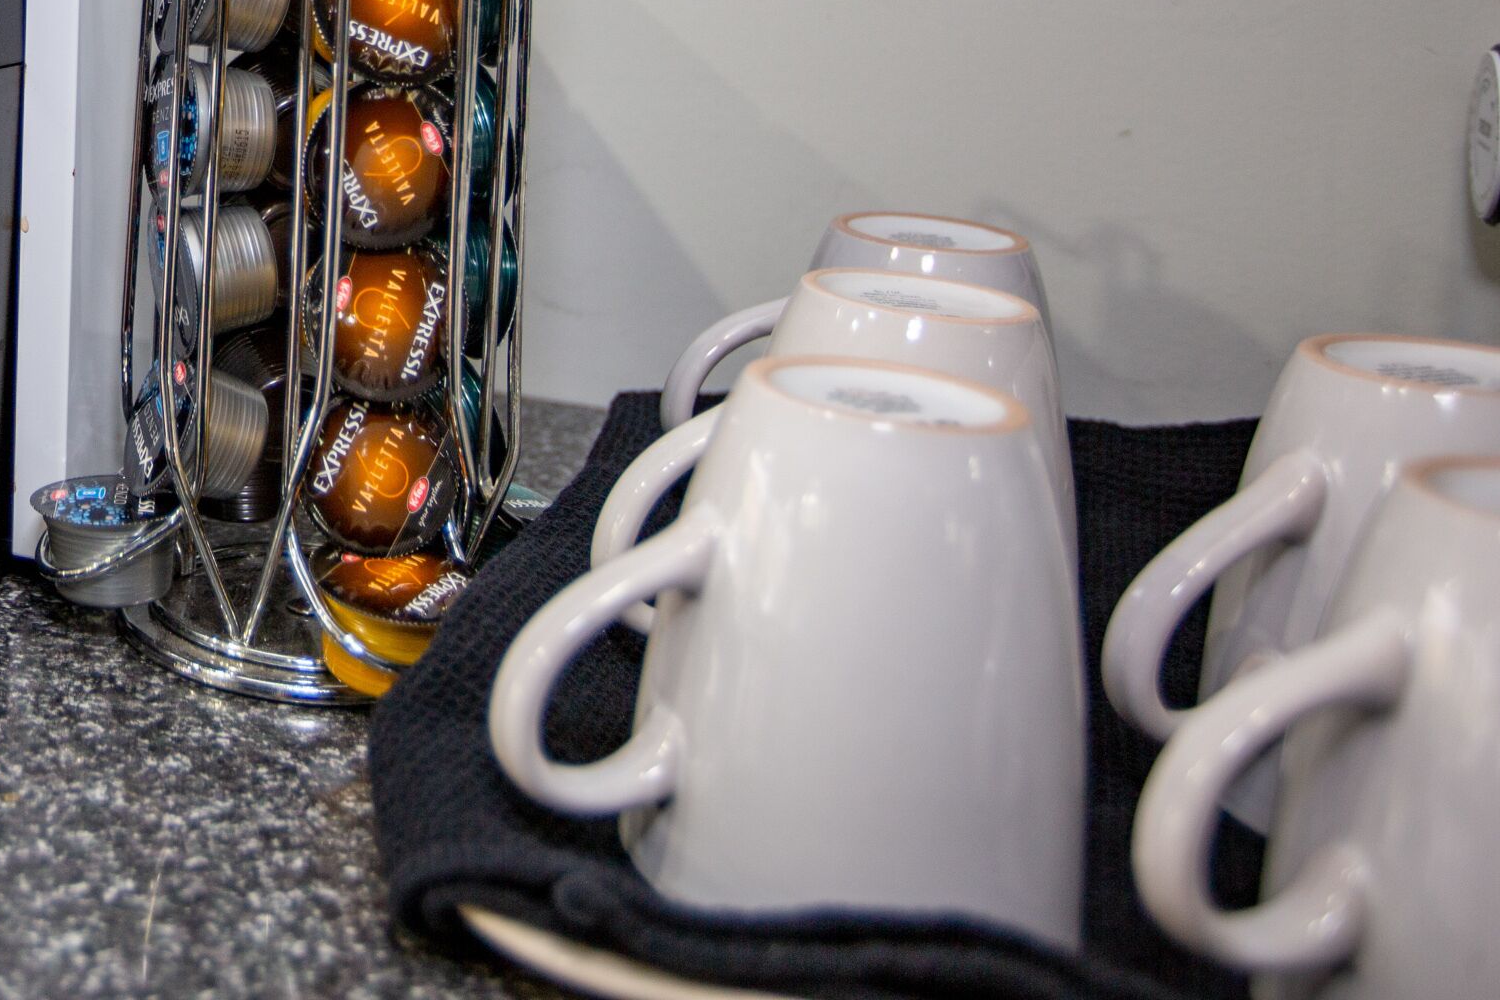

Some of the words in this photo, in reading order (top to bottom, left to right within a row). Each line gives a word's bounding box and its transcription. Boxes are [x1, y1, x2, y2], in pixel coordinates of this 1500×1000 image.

[349, 20, 430, 68] EXPRESS
[365, 120, 416, 206] VALLETTA
[364, 268, 407, 359] VALLETTA
[352, 426, 405, 514] VALLETTA
